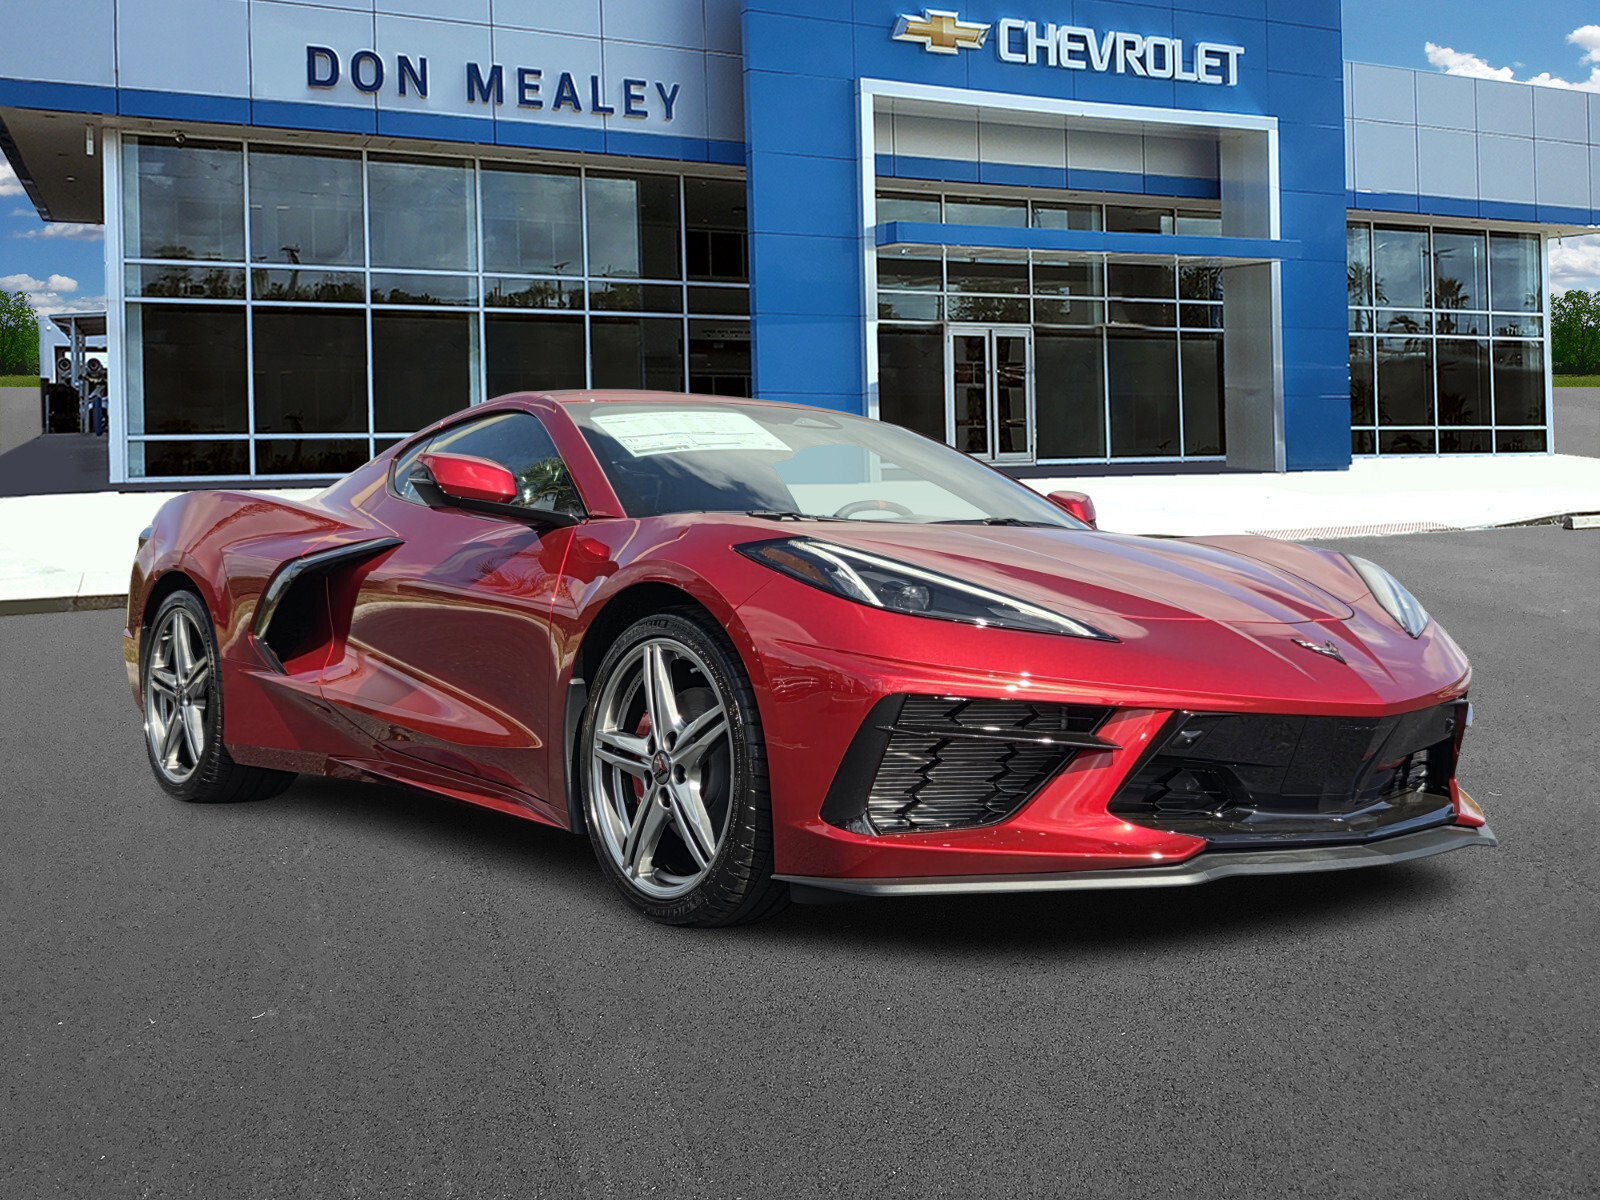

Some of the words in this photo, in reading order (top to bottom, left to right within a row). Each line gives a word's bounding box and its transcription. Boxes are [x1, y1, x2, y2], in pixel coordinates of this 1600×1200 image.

[306, 45, 428, 99] DON
[466, 62, 680, 122] MEALEY
[997, 17, 1245, 87] CHEVROLET
